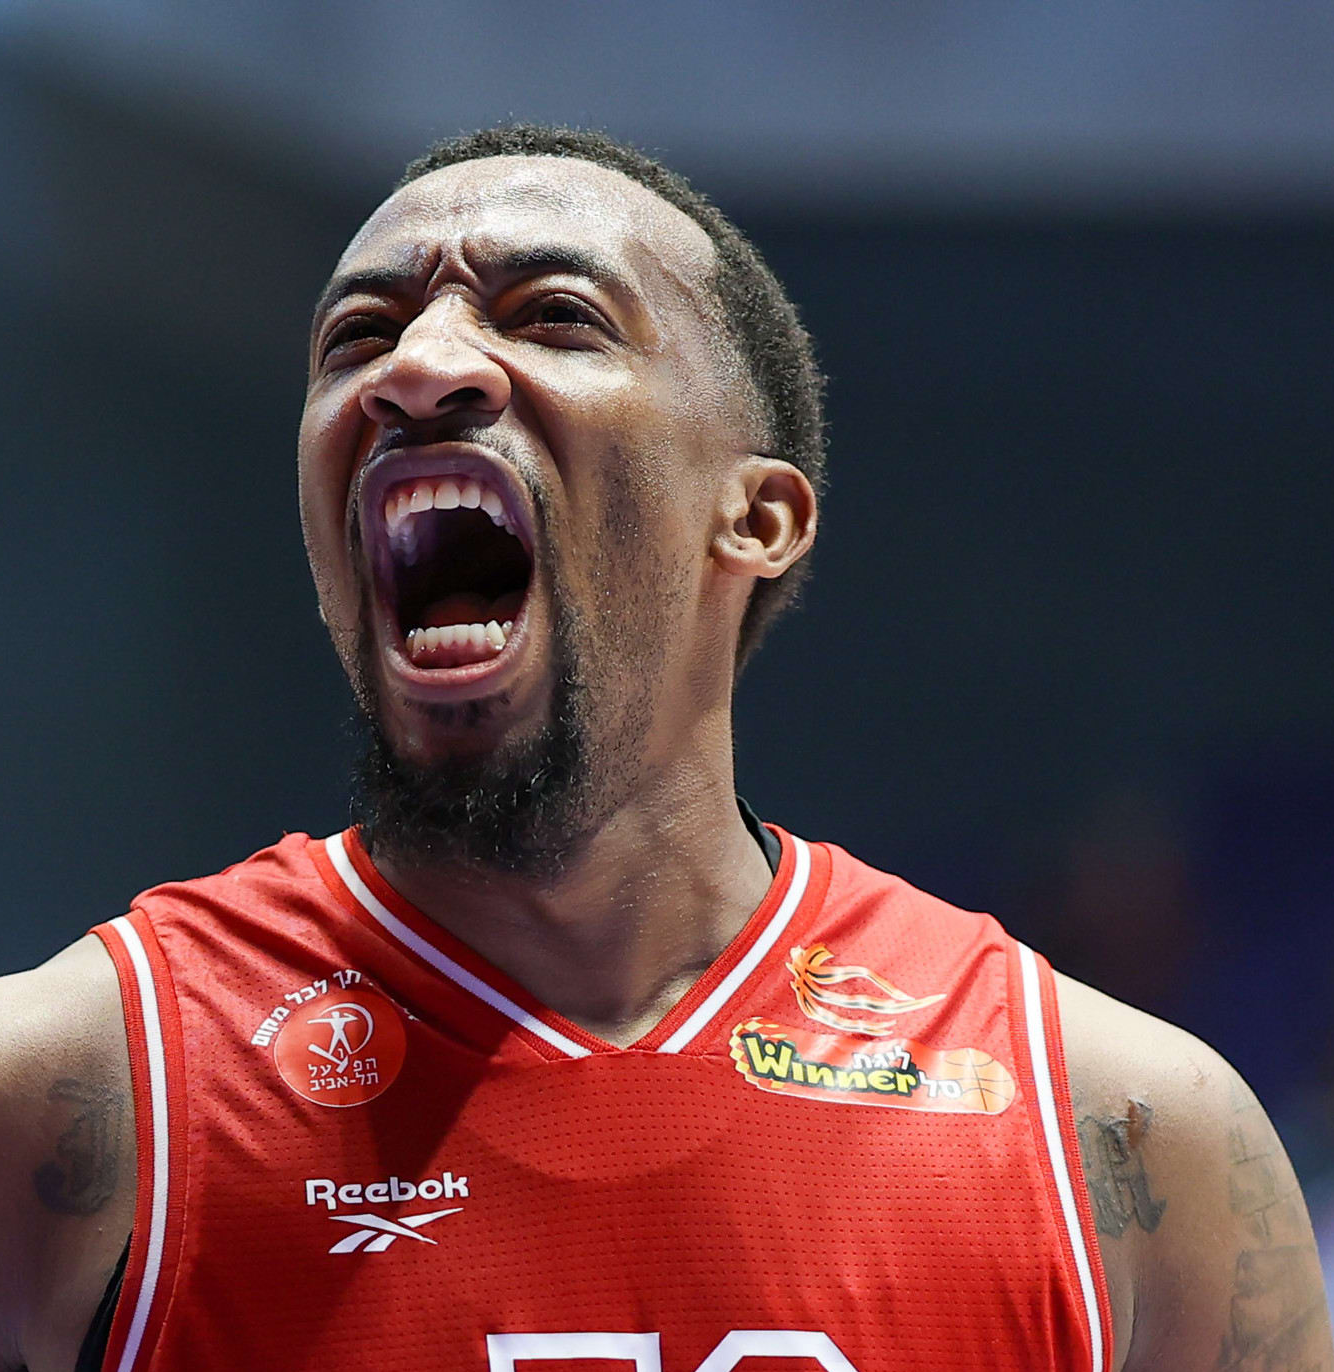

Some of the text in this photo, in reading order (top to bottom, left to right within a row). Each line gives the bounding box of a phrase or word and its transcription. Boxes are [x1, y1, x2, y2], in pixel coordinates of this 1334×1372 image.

[284, 978, 329, 1006] לכל
[251, 1005, 290, 1047] מקום
[743, 1034, 919, 1096] Winner
[305, 1171, 470, 1211] Reebok
